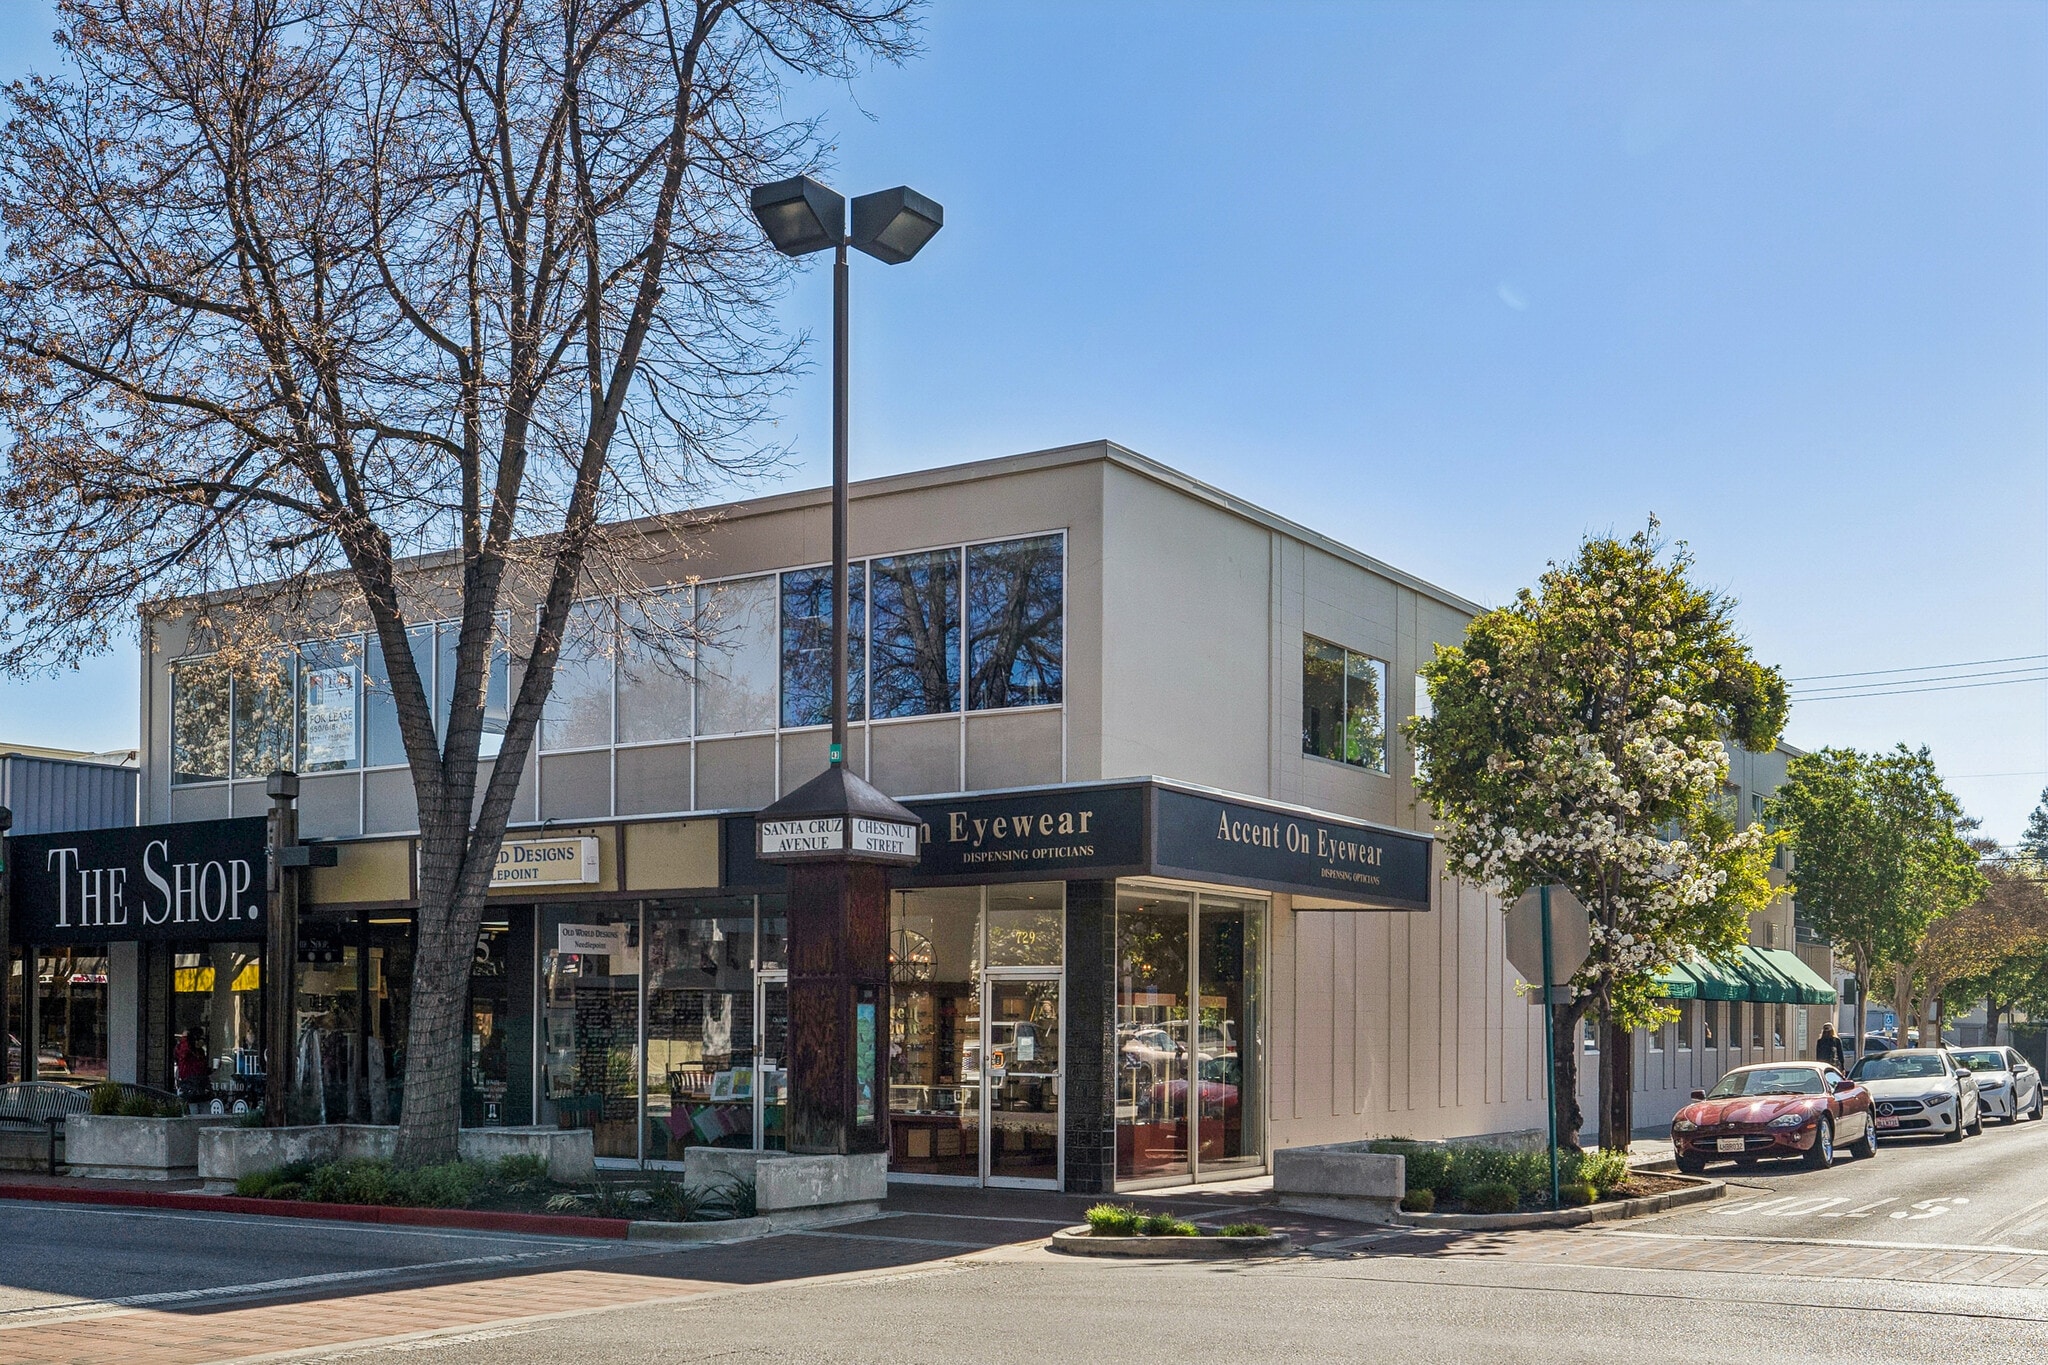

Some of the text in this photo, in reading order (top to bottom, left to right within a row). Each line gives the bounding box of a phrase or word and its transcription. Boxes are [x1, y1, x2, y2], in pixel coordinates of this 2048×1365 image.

[309, 710, 353, 724] FOR LEASE
[763, 819, 843, 835] SANTA CRUZ
[858, 820, 912, 838] CHESTNUT
[920, 810, 1093, 847] n Eyewear
[779, 836, 829, 851] AVENUE
[866, 838, 904, 853] STREET
[1217, 810, 1383, 867] Accent On Eyewear
[513, 846, 574, 863] DESIGNS
[963, 845, 1094, 863] DISPENSING OPTICIANS
[491, 868, 539, 881] LEPOINT
[1321, 867, 1380, 886] DISPENSING OPTICIANS
[47, 848, 127, 927] THE
[1016, 931, 1036, 945] 729
